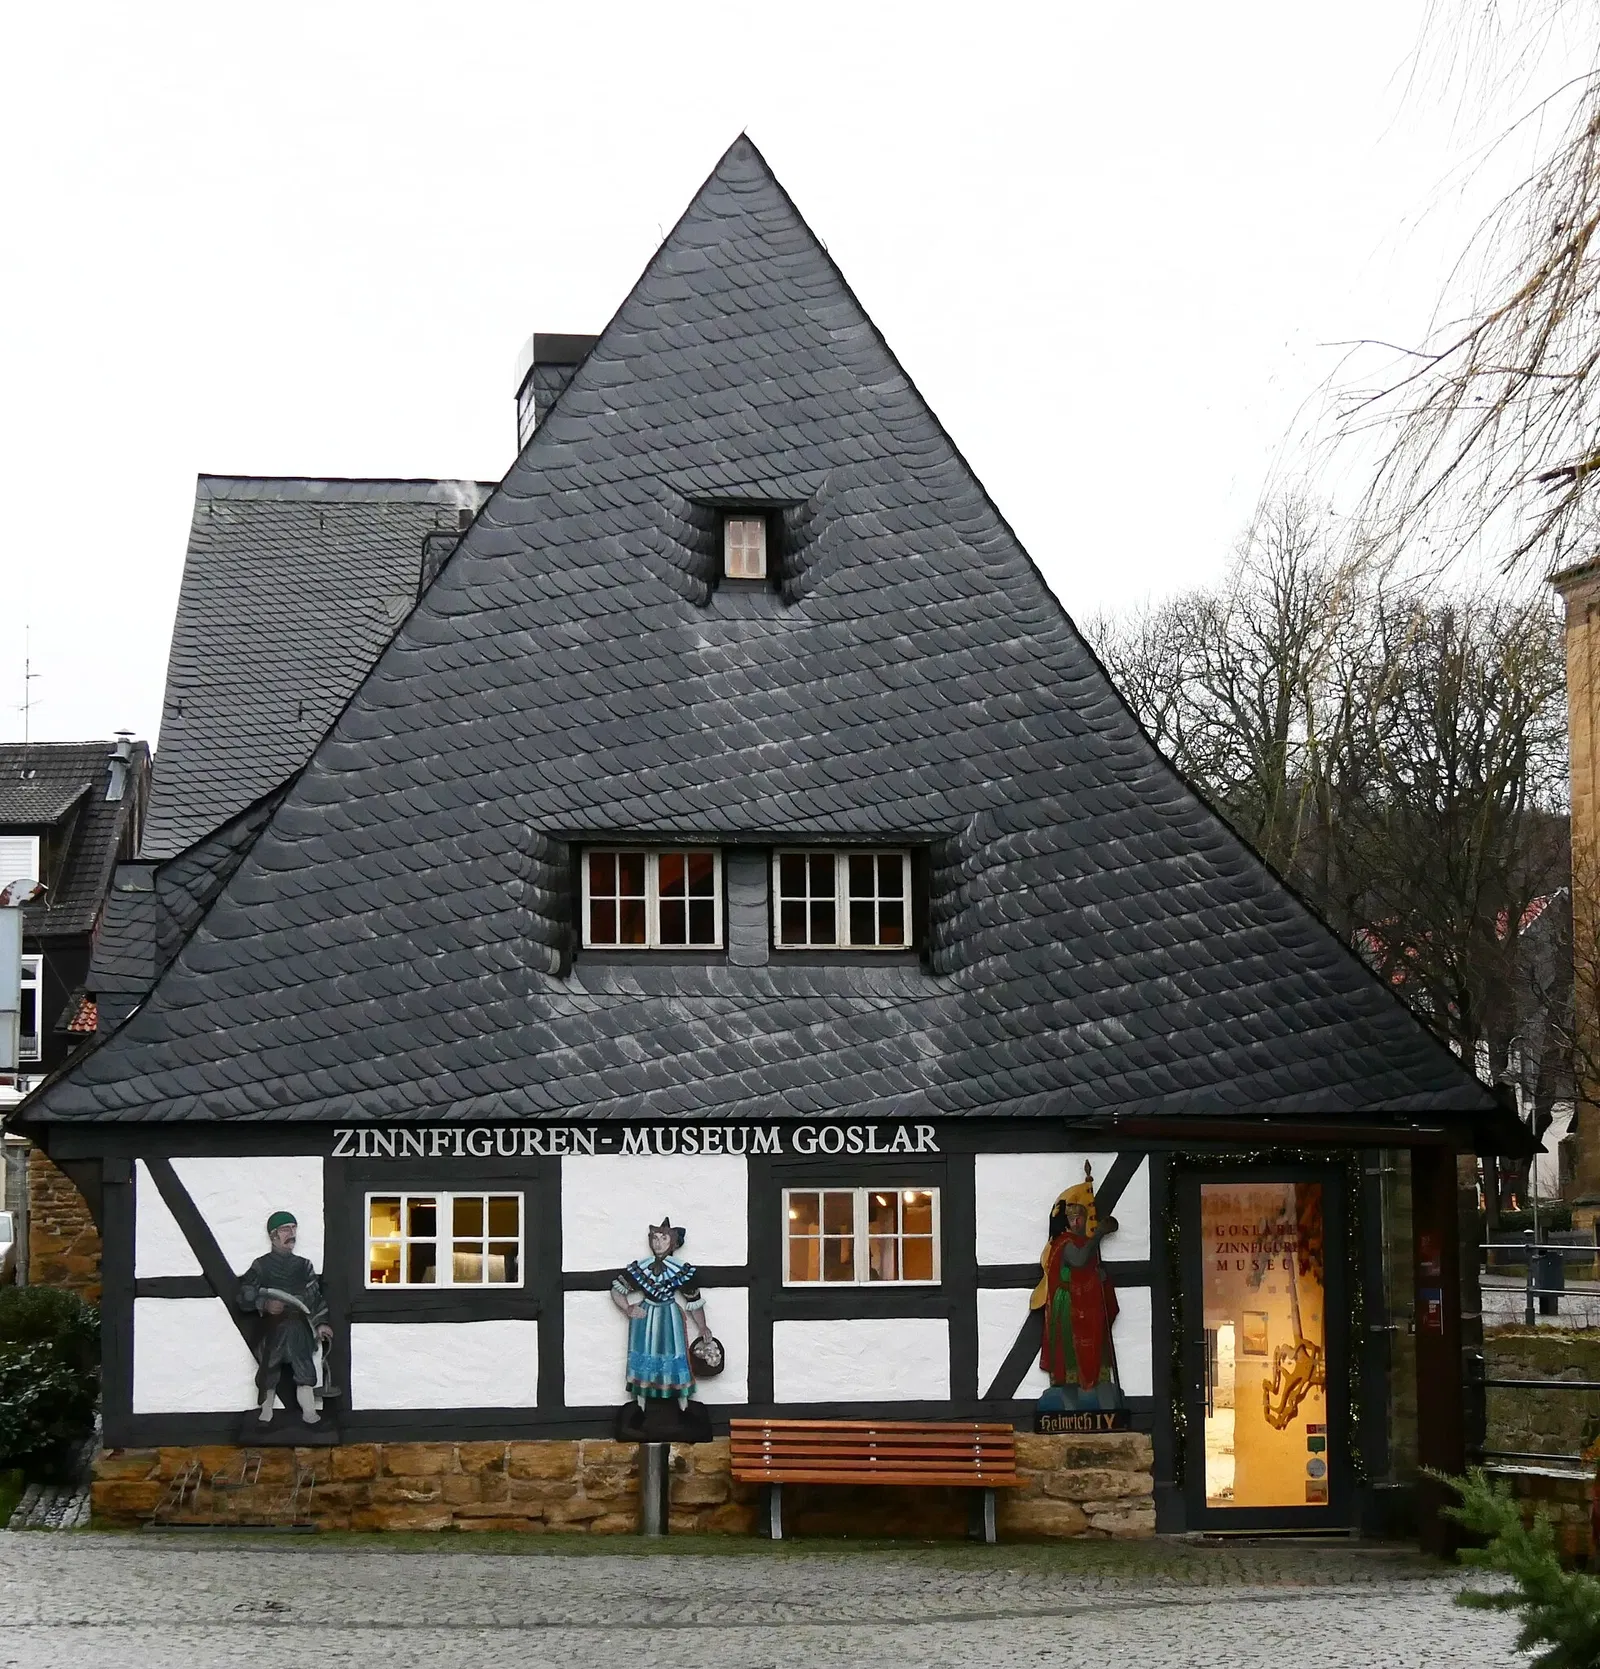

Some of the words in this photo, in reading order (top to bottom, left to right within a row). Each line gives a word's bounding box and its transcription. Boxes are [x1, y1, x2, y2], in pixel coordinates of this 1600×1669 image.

[792, 1125, 941, 1154] GOSLAR
[1215, 1224, 1308, 1237] GOSLARE
[1215, 1242, 1309, 1254] ZINNFIGURE
[1040, 1412, 1092, 1432] Heinrich
